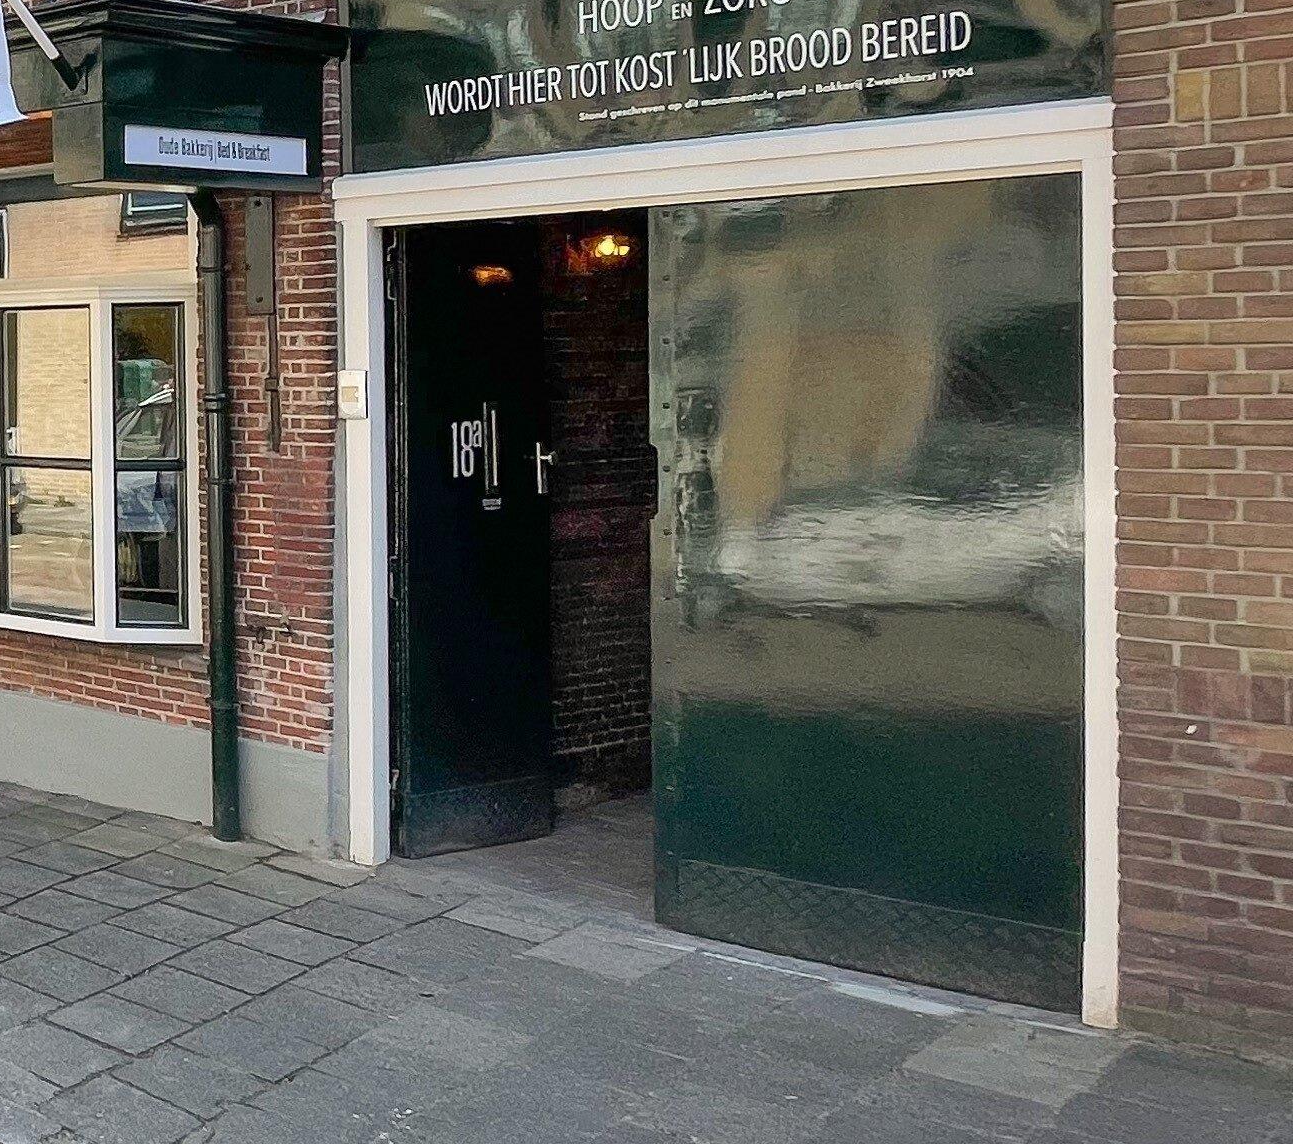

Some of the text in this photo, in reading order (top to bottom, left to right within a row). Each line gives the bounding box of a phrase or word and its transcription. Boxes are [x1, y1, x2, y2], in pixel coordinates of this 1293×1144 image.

[671, 1, 694, 23] EN
[424, 74, 502, 118] WORDT
[507, 64, 564, 109] HIER
[566, 60, 610, 100] TOT
[614, 50, 677, 94] KOST
[750, 29, 853, 79] BROOD
[861, 10, 972, 62] BEREID
[578, 108, 608, 122] Stond
[669, 102, 683, 112] op
[685, 97, 700, 109] dit
[777, 84, 807, 101] pand
[815, 80, 863, 96] Bakkerij
[941, 66, 975, 79] 1904
[158, 136, 271, 161] Oude Bakkerij Bed & Breakfast
